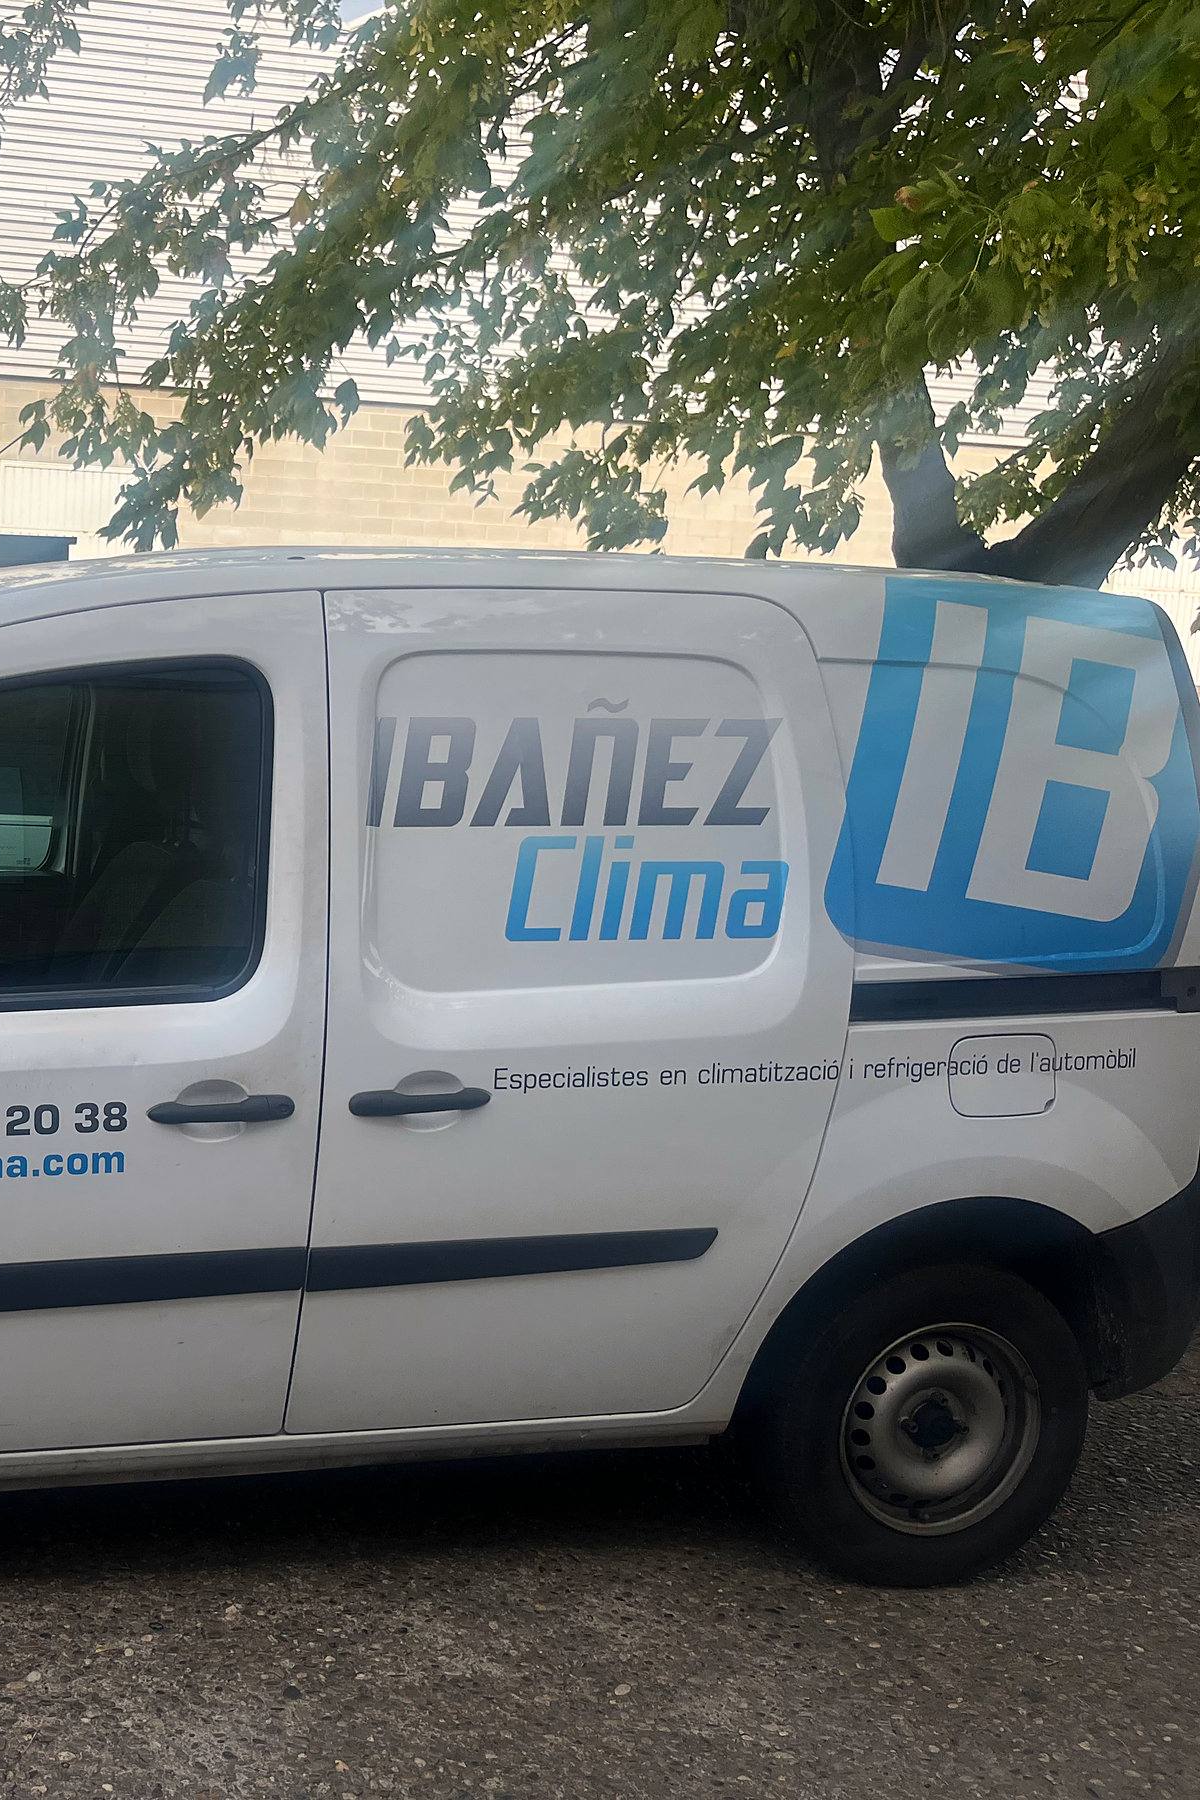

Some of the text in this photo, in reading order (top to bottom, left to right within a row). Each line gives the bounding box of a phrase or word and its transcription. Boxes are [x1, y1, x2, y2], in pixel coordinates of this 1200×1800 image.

[365, 697, 783, 827] IBAÑEZ
[875, 600, 1179, 922] IB
[504, 835, 790, 942] Clima
[5, 1104, 60, 1136] 20
[74, 1101, 128, 1134] 38
[493, 1047, 1137, 1094] Especialistes en climatització i refrigeració de l'automòbil
